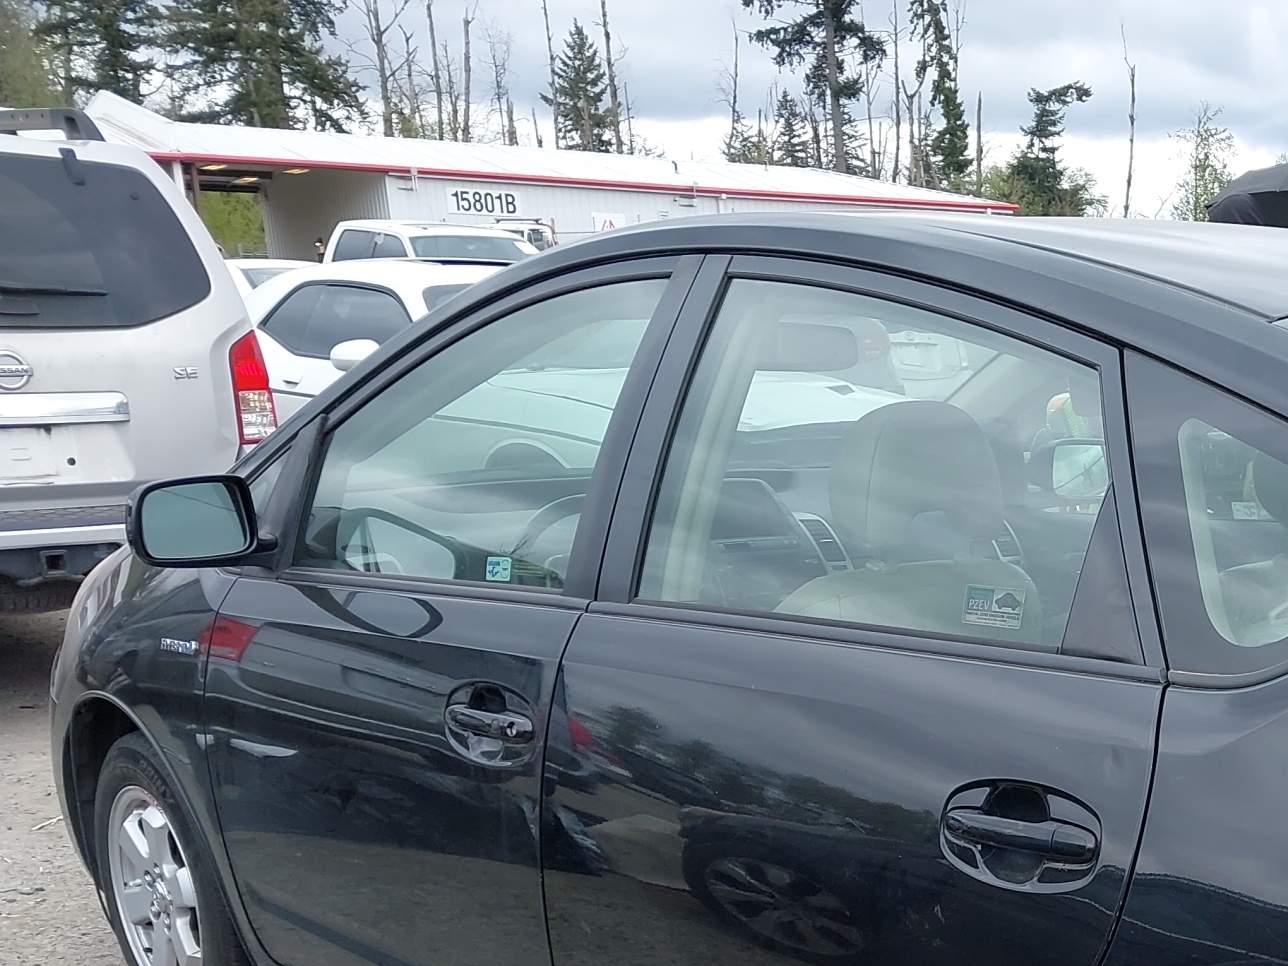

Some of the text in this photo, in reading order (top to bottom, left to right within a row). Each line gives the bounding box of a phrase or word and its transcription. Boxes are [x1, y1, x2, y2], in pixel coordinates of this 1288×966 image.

[451, 190, 517, 214] 15801B
[172, 366, 200, 380] SE
[968, 599, 990, 610] PZEV
